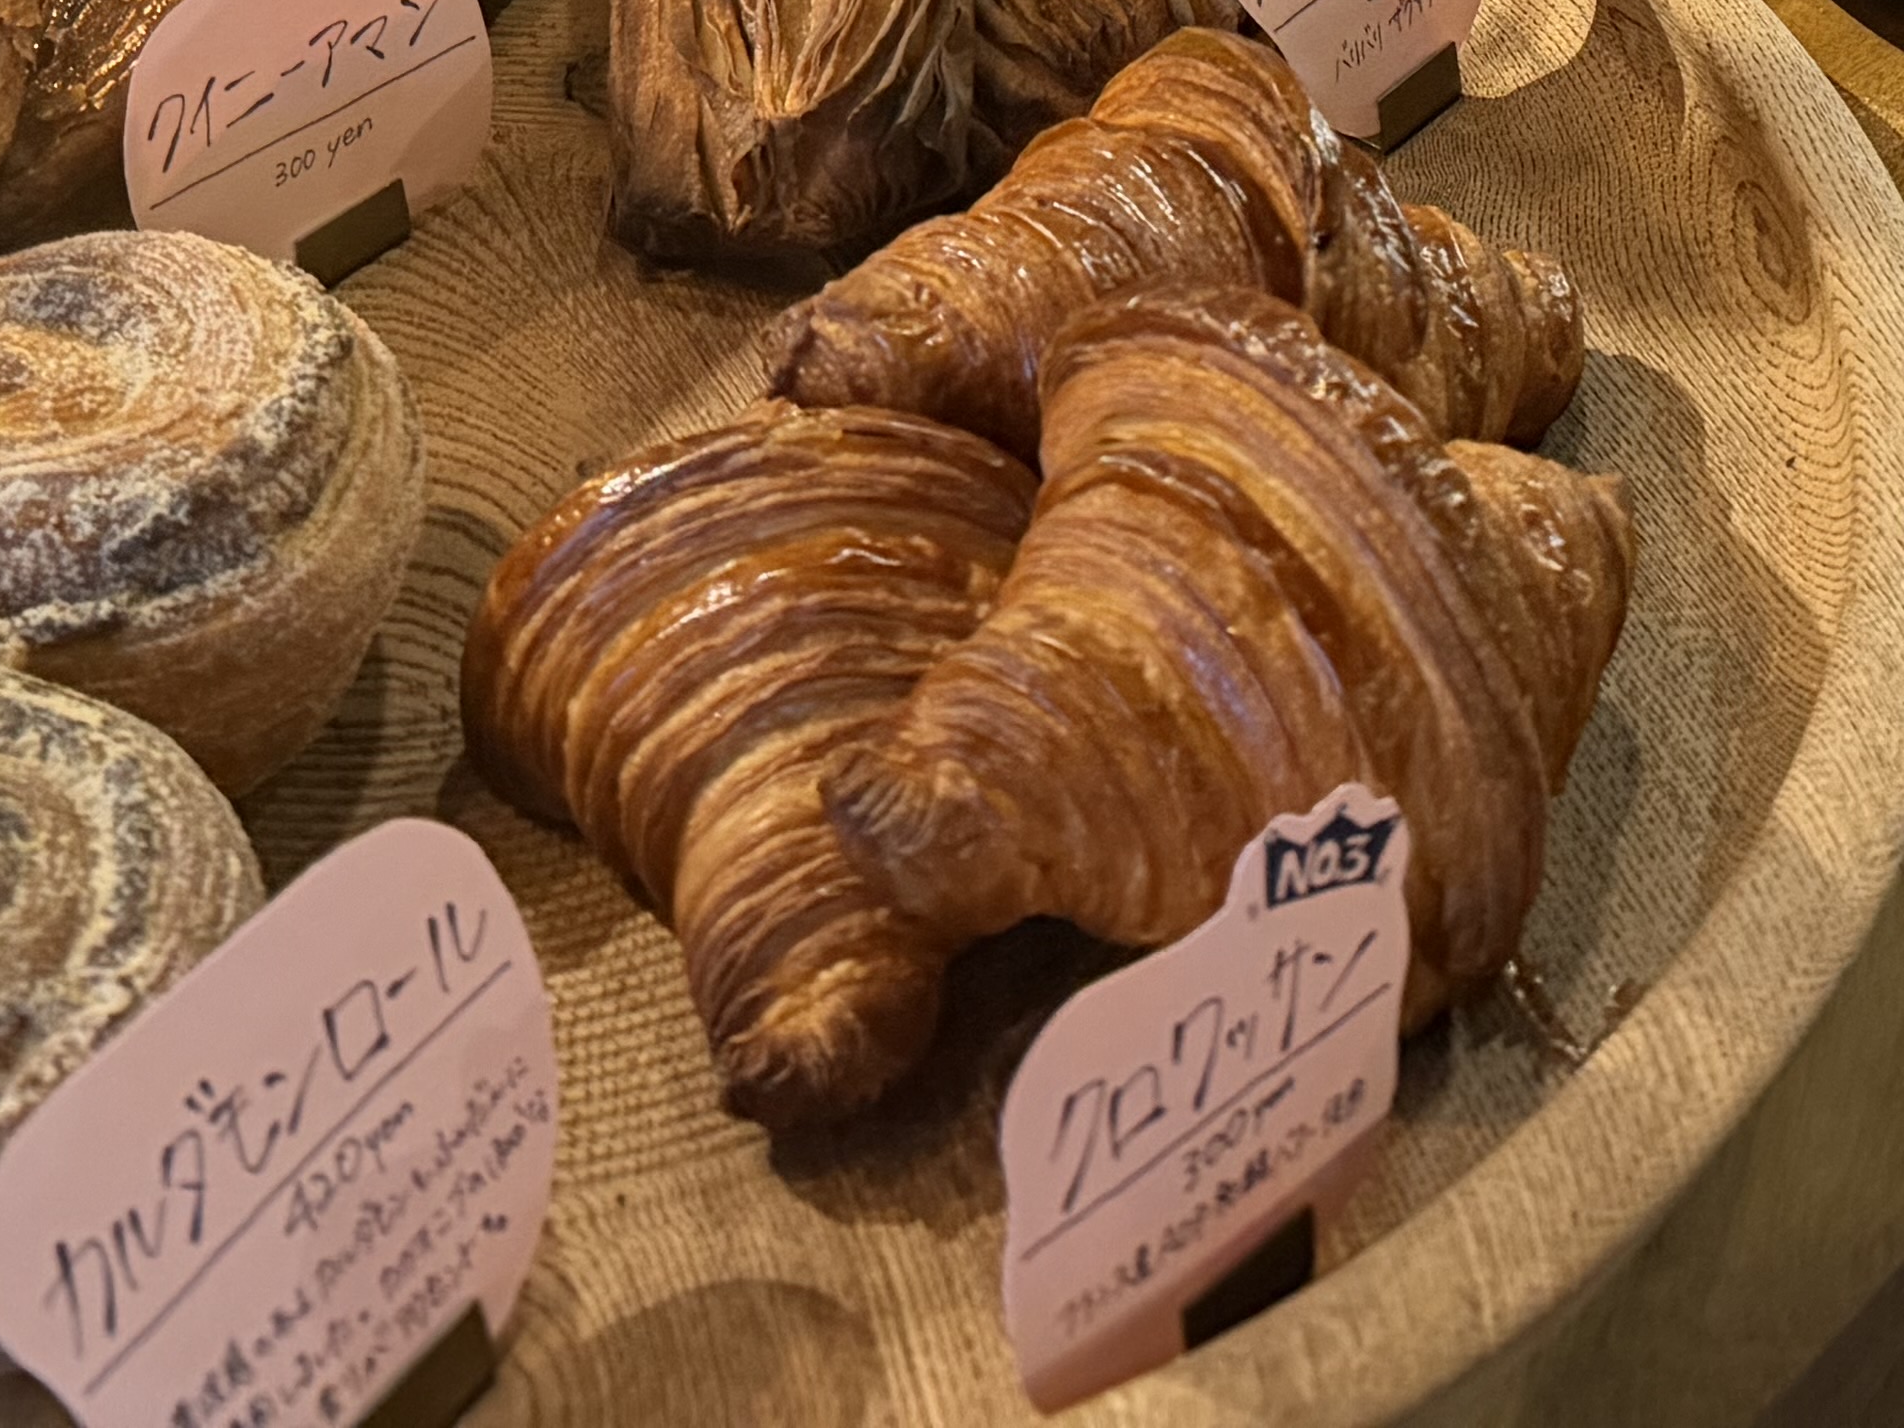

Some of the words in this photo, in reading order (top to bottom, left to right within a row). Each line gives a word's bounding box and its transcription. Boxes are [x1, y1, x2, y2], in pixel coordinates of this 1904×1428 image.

[274, 148, 316, 188] 300
[326, 115, 374, 169] yen
[43, 901, 489, 1359] カルダモンロール
[1048, 929, 1379, 1216] クロワッサン
